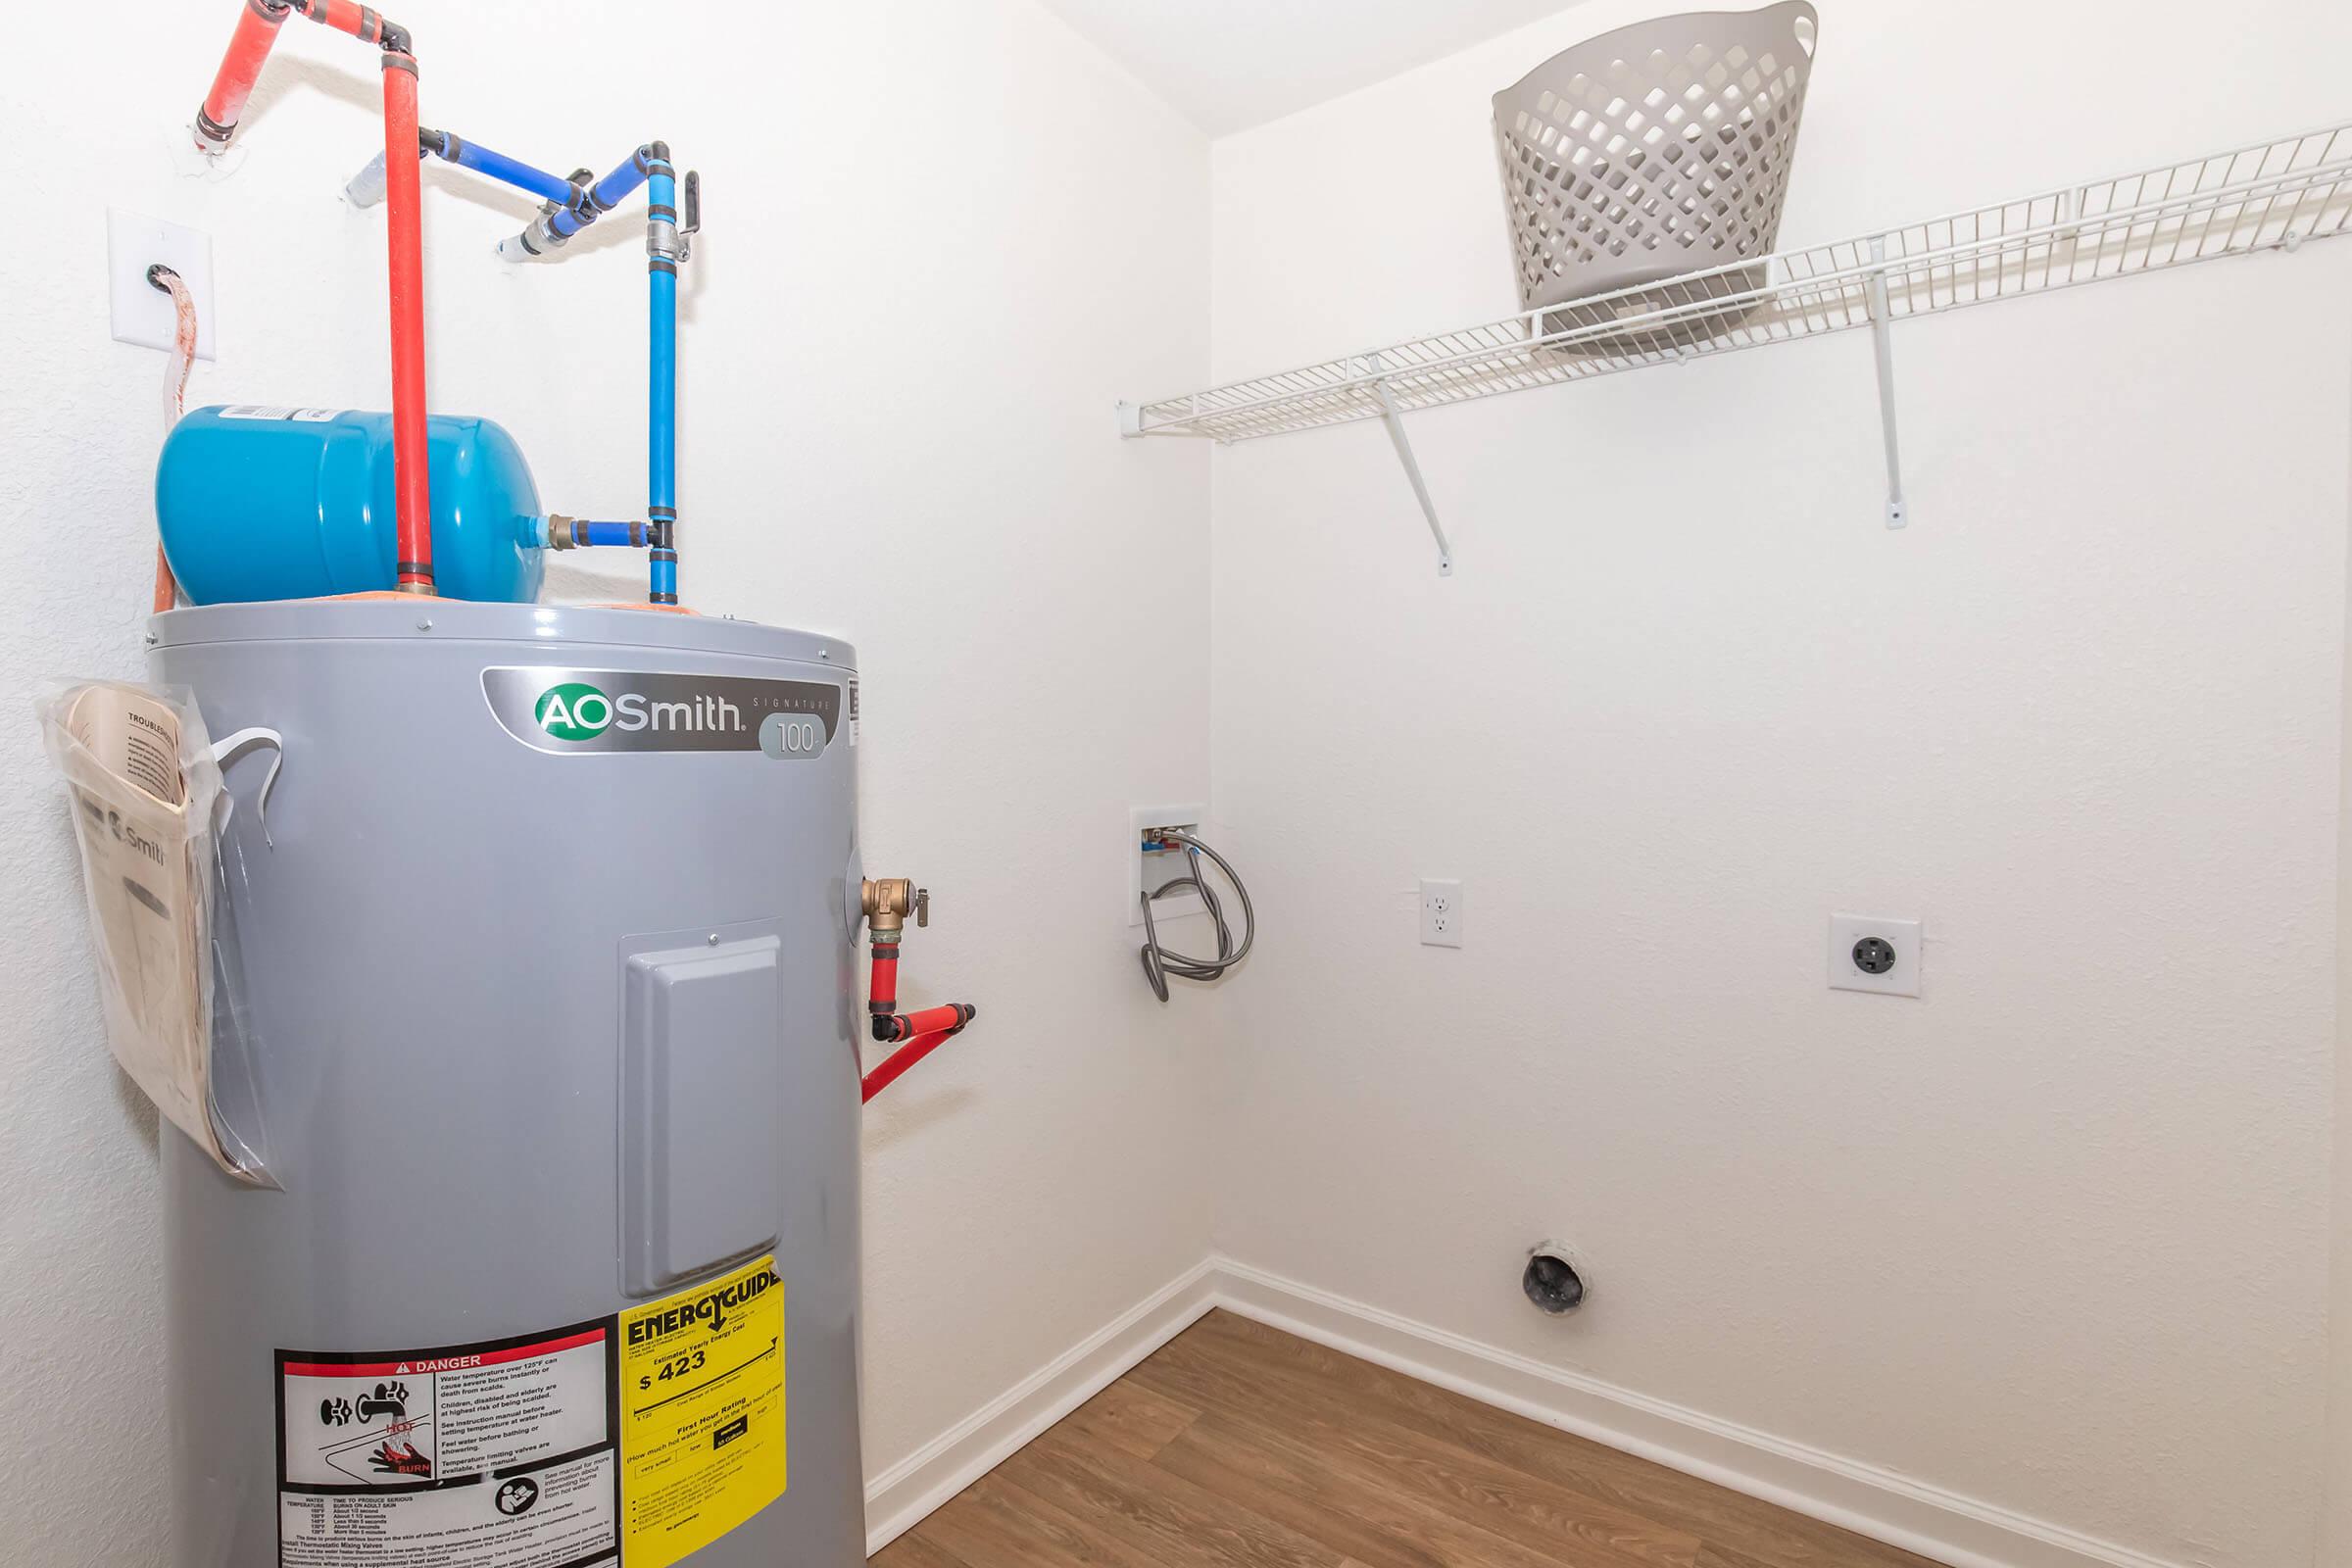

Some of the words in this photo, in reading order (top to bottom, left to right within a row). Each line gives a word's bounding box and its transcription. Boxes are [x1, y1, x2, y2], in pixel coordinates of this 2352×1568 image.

[753, 697, 830, 710] SIGNATURE
[776, 721, 815, 753] 100
[654, 1348, 686, 1365] Estimated
[689, 1340, 709, 1353] Yearly
[710, 1331, 731, 1344] Energy
[733, 1323, 745, 1333] Cost
[416, 1355, 481, 1372] DANGER
[639, 1376, 651, 1390] $
[658, 1349, 706, 1381] 423
[463, 1368, 505, 1380] temperature
[488, 1374, 509, 1383] burns
[510, 1369, 540, 1381] instantly
[441, 1400, 472, 1409] Children,
[474, 1395, 504, 1405] disabled
[520, 1387, 544, 1396] elderly
[480, 1384, 506, 1393] scalds.
[449, 1405, 475, 1417] highest
[501, 1399, 520, 1409] being
[522, 1393, 551, 1403] scalded.
[441, 1427, 466, 1437] setting
[466, 1420, 510, 1434] temperature
[519, 1414, 539, 1423] water
[540, 1408, 564, 1418] heater.
[456, 1416, 494, 1427] instruction
[496, 1410, 521, 1421] manual
[522, 1405, 545, 1415] before
[677, 1421, 697, 1435] First
[700, 1411, 719, 1425] Hour
[721, 1396, 746, 1413] Rating
[386, 1422, 416, 1434] HOT
[479, 1433, 502, 1442] before
[503, 1426, 529, 1439] bathing
[442, 1445, 479, 1455] showering.
[627, 1453, 646, 1464] (How
[647, 1444, 666, 1455] much
[668, 1438, 680, 1447] hot
[681, 1430, 699, 1441] water
[701, 1424, 712, 1434] you
[442, 1454, 485, 1467] Temperature
[487, 1448, 514, 1460] limiting
[514, 1445, 537, 1454] valves
[442, 1464, 475, 1475] available,
[490, 1456, 518, 1466] manual.
[559, 1464, 582, 1475] manual
[594, 1456, 610, 1465] more
[641, 1463, 654, 1473] very
[656, 1456, 671, 1467] small
[689, 1443, 702, 1451] low
[398, 1463, 430, 1473] BURN
[545, 1472, 579, 1486] information
[582, 1466, 599, 1475] about
[545, 1480, 578, 1493] preventing
